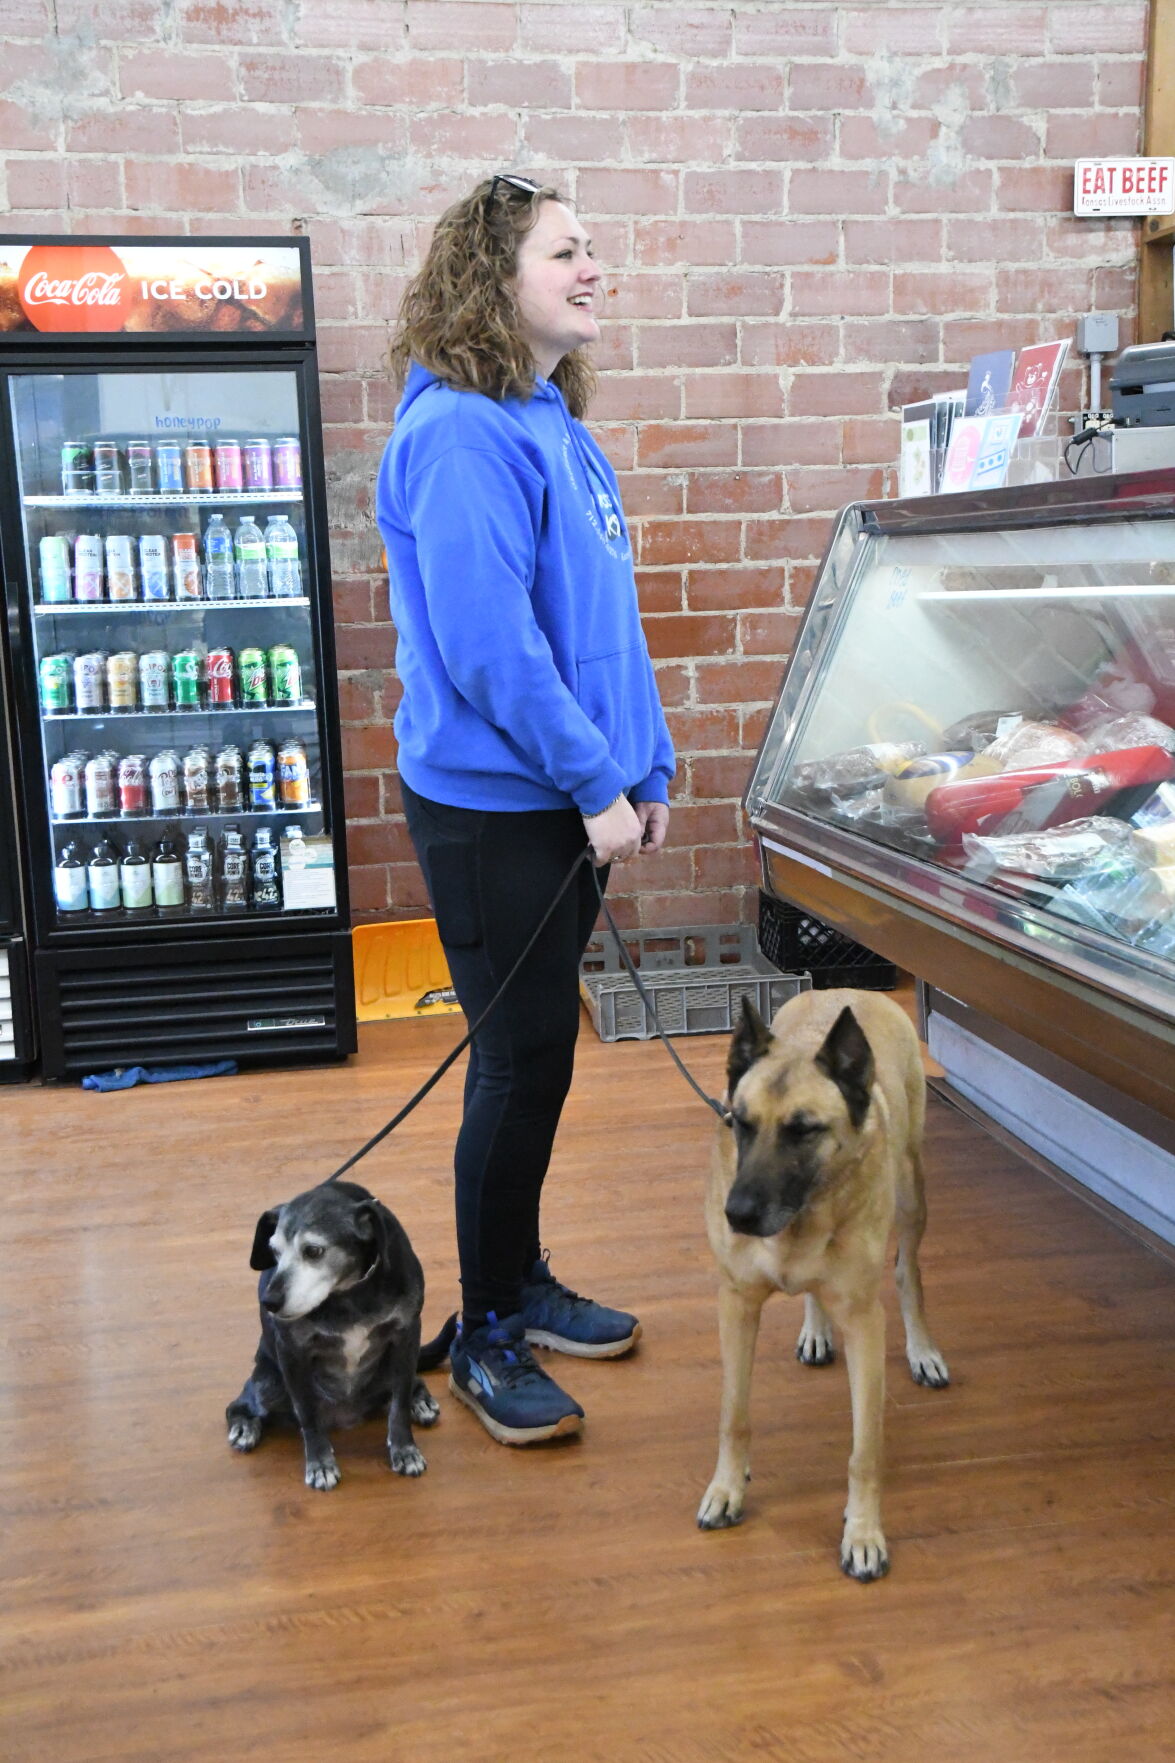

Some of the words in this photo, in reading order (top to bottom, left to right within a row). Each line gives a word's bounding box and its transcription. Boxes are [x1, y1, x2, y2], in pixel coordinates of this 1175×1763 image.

[1082, 167, 1117, 194] EAT
[1122, 166, 1168, 193] BEEF
[1082, 196, 1107, 207] Kansas
[24, 271, 125, 306] Coca-Cola
[141, 280, 186, 300] ICE
[194, 280, 267, 300] COLD
[155, 415, 221, 430] honeypop
[227, 862, 240, 870] CORE
